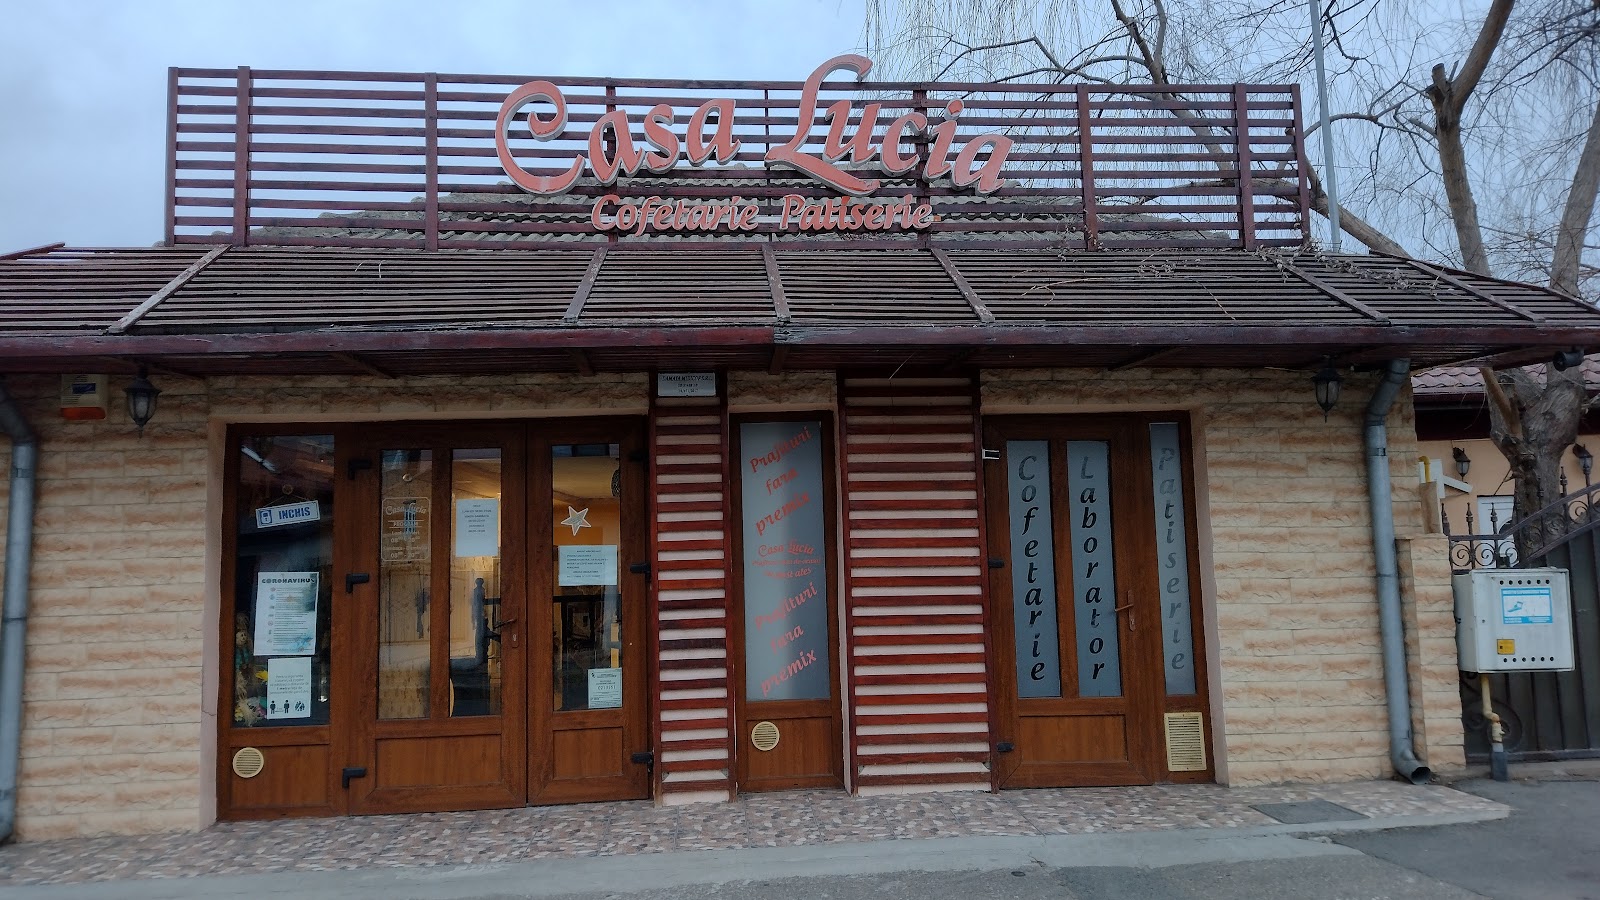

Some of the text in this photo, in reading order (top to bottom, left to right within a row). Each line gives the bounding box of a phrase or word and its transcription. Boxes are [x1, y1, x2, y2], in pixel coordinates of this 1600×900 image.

[495, 53, 1016, 196] Casa Lucia
[590, 193, 934, 236] Cofetarie Patiserie
[749, 425, 812, 474] Prajituri
[764, 466, 799, 496] fara
[278, 506, 311, 520] INCHIS
[385, 505, 405, 516] Casa
[755, 489, 811, 537] premix
[757, 539, 815, 558] Casa Lucia
[1018, 455, 1046, 681] Cofetarie
[1079, 455, 1105, 680] Laborator
[1157, 447, 1185, 670] Patiserie
[794, 567, 812, 578] ales
[770, 624, 804, 655] fara
[761, 649, 817, 697] premix
